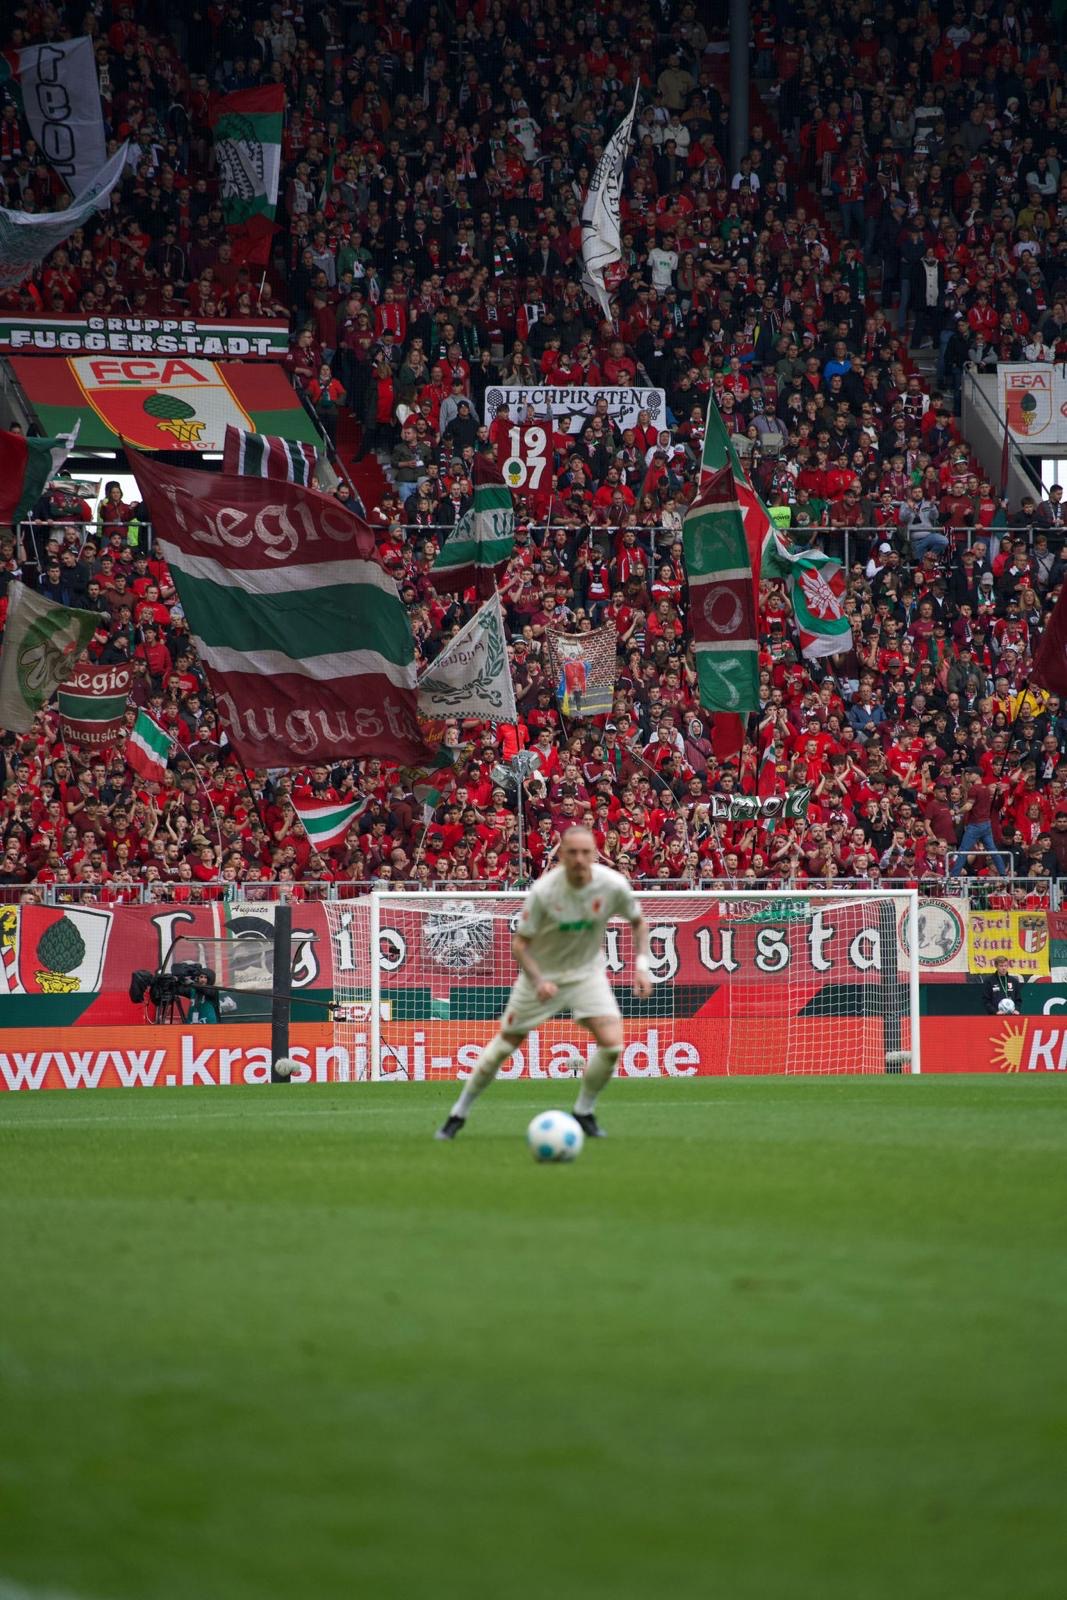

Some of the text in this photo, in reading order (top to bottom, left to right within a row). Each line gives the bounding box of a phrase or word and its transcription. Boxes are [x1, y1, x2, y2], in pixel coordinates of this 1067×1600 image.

[87, 317, 197, 333] GRUPPE
[9, 329, 273, 356] FUGGERSTADT
[90, 359, 210, 384] FCA
[1010, 375, 1046, 389] FCA
[508, 427, 547, 457] 19
[159, 484, 356, 560] Legio
[974, 955, 1038, 969] Baern
